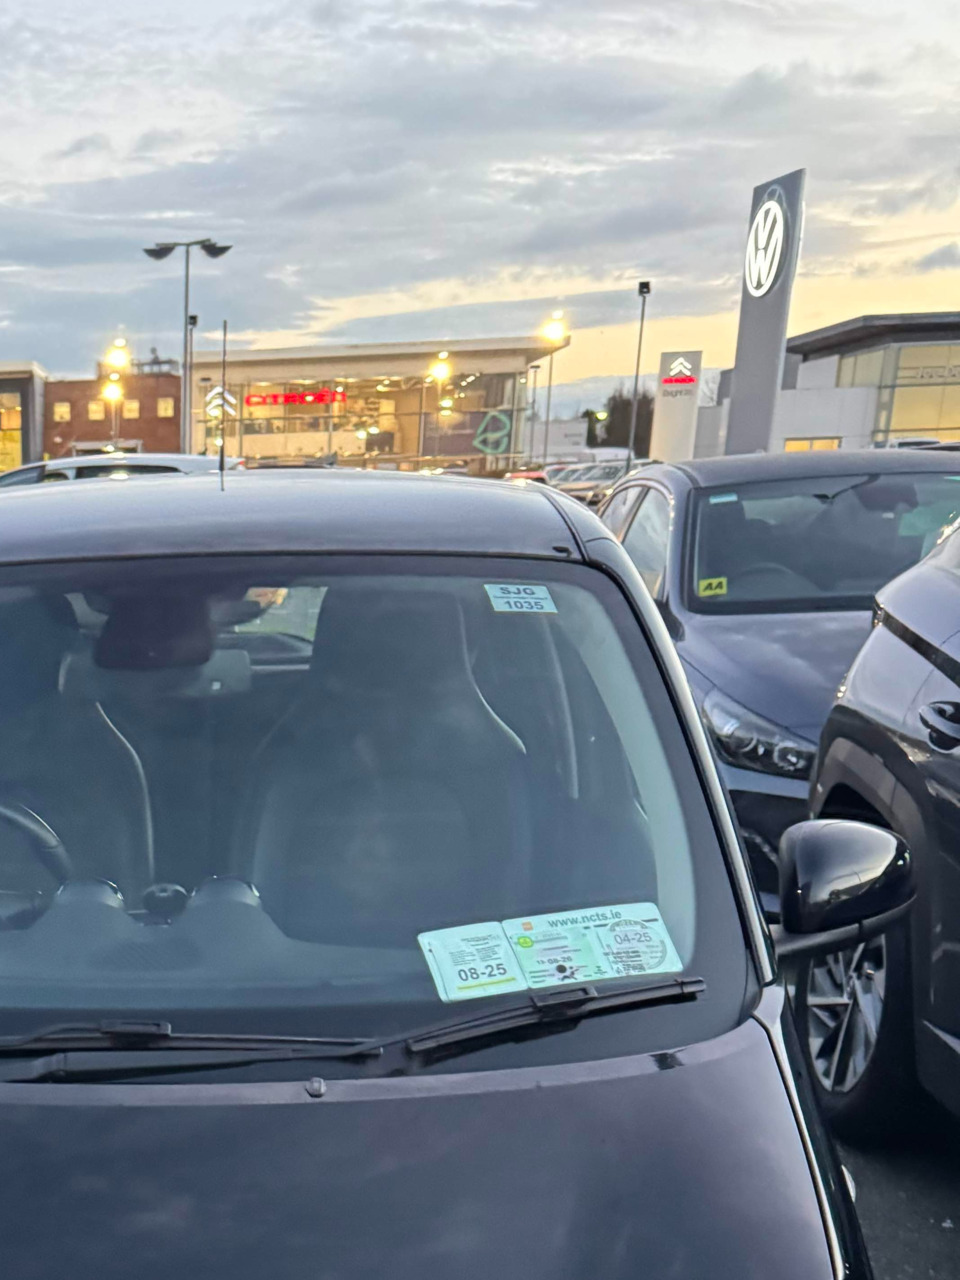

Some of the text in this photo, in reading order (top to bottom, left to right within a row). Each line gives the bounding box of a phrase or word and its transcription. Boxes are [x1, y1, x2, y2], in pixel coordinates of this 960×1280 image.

[702, 580, 724, 593] AA
[504, 600, 545, 611] 1035
[547, 909, 622, 928] www.ncts.ie
[613, 931, 653, 945] 04-25
[457, 962, 508, 982] 08-25
